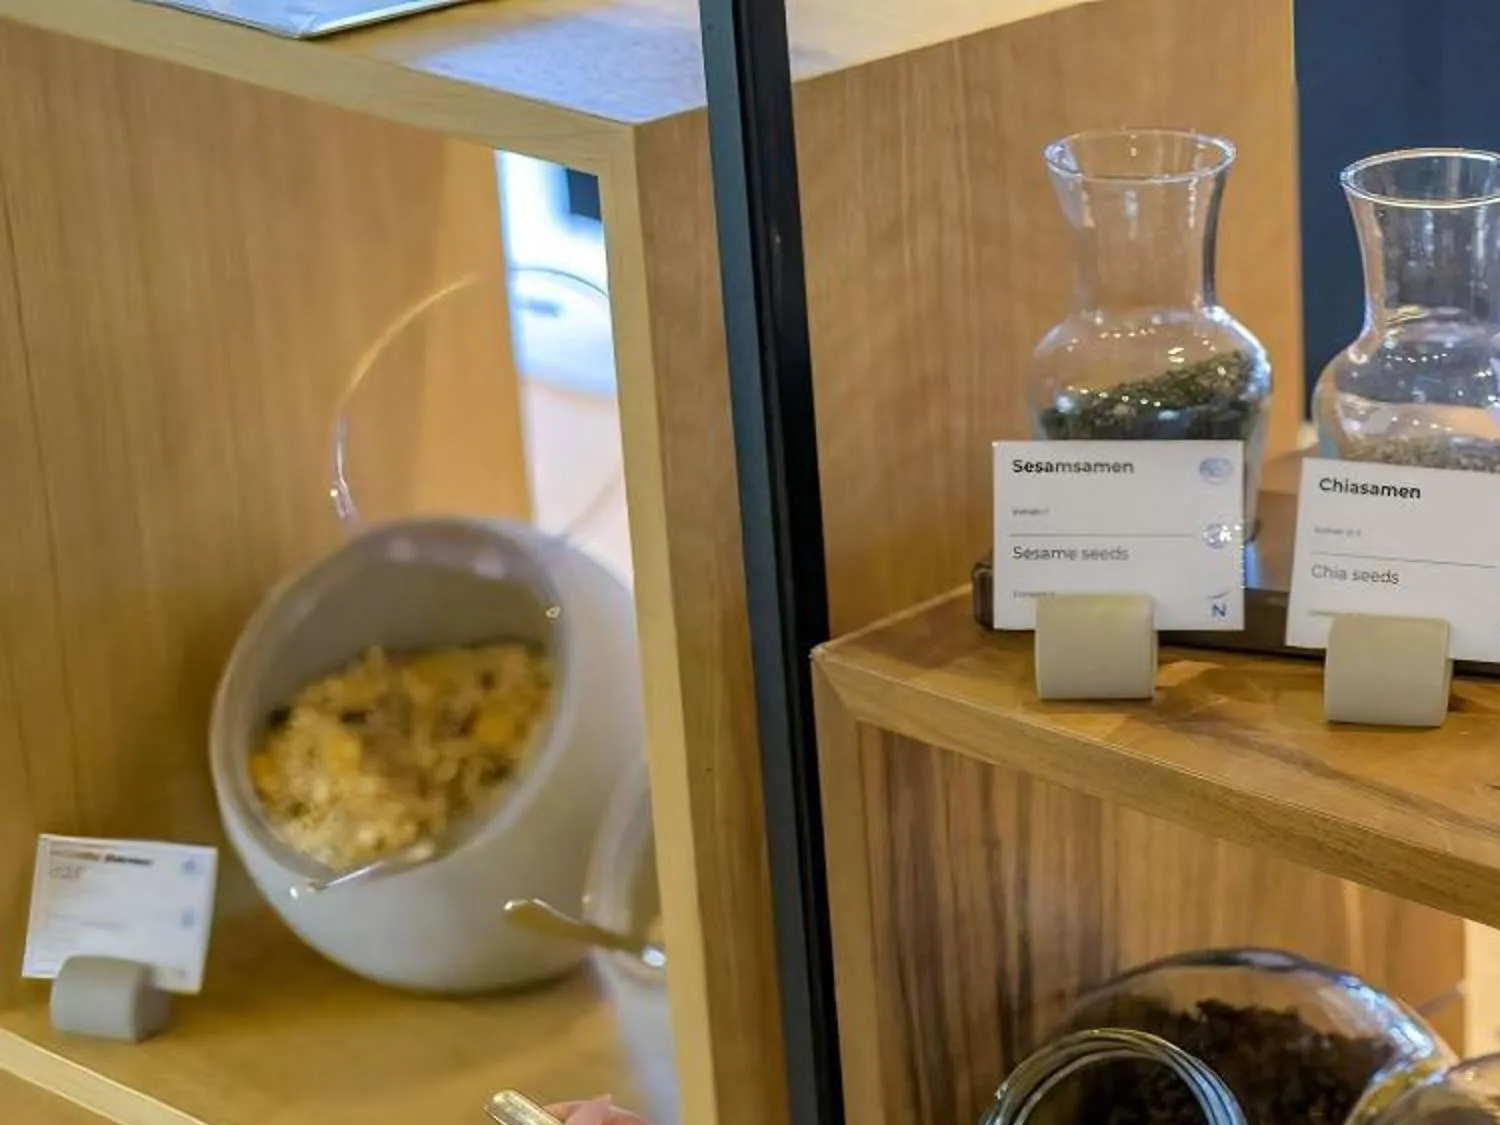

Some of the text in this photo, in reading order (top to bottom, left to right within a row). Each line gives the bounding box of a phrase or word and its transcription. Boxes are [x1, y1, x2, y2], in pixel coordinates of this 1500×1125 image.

[1012, 459, 1134, 474] Sesamsamen
[1319, 478, 1421, 499] Chiasamen
[1012, 545, 1130, 561] Sesame seeds
[1311, 564, 1400, 585] Chia seeds
